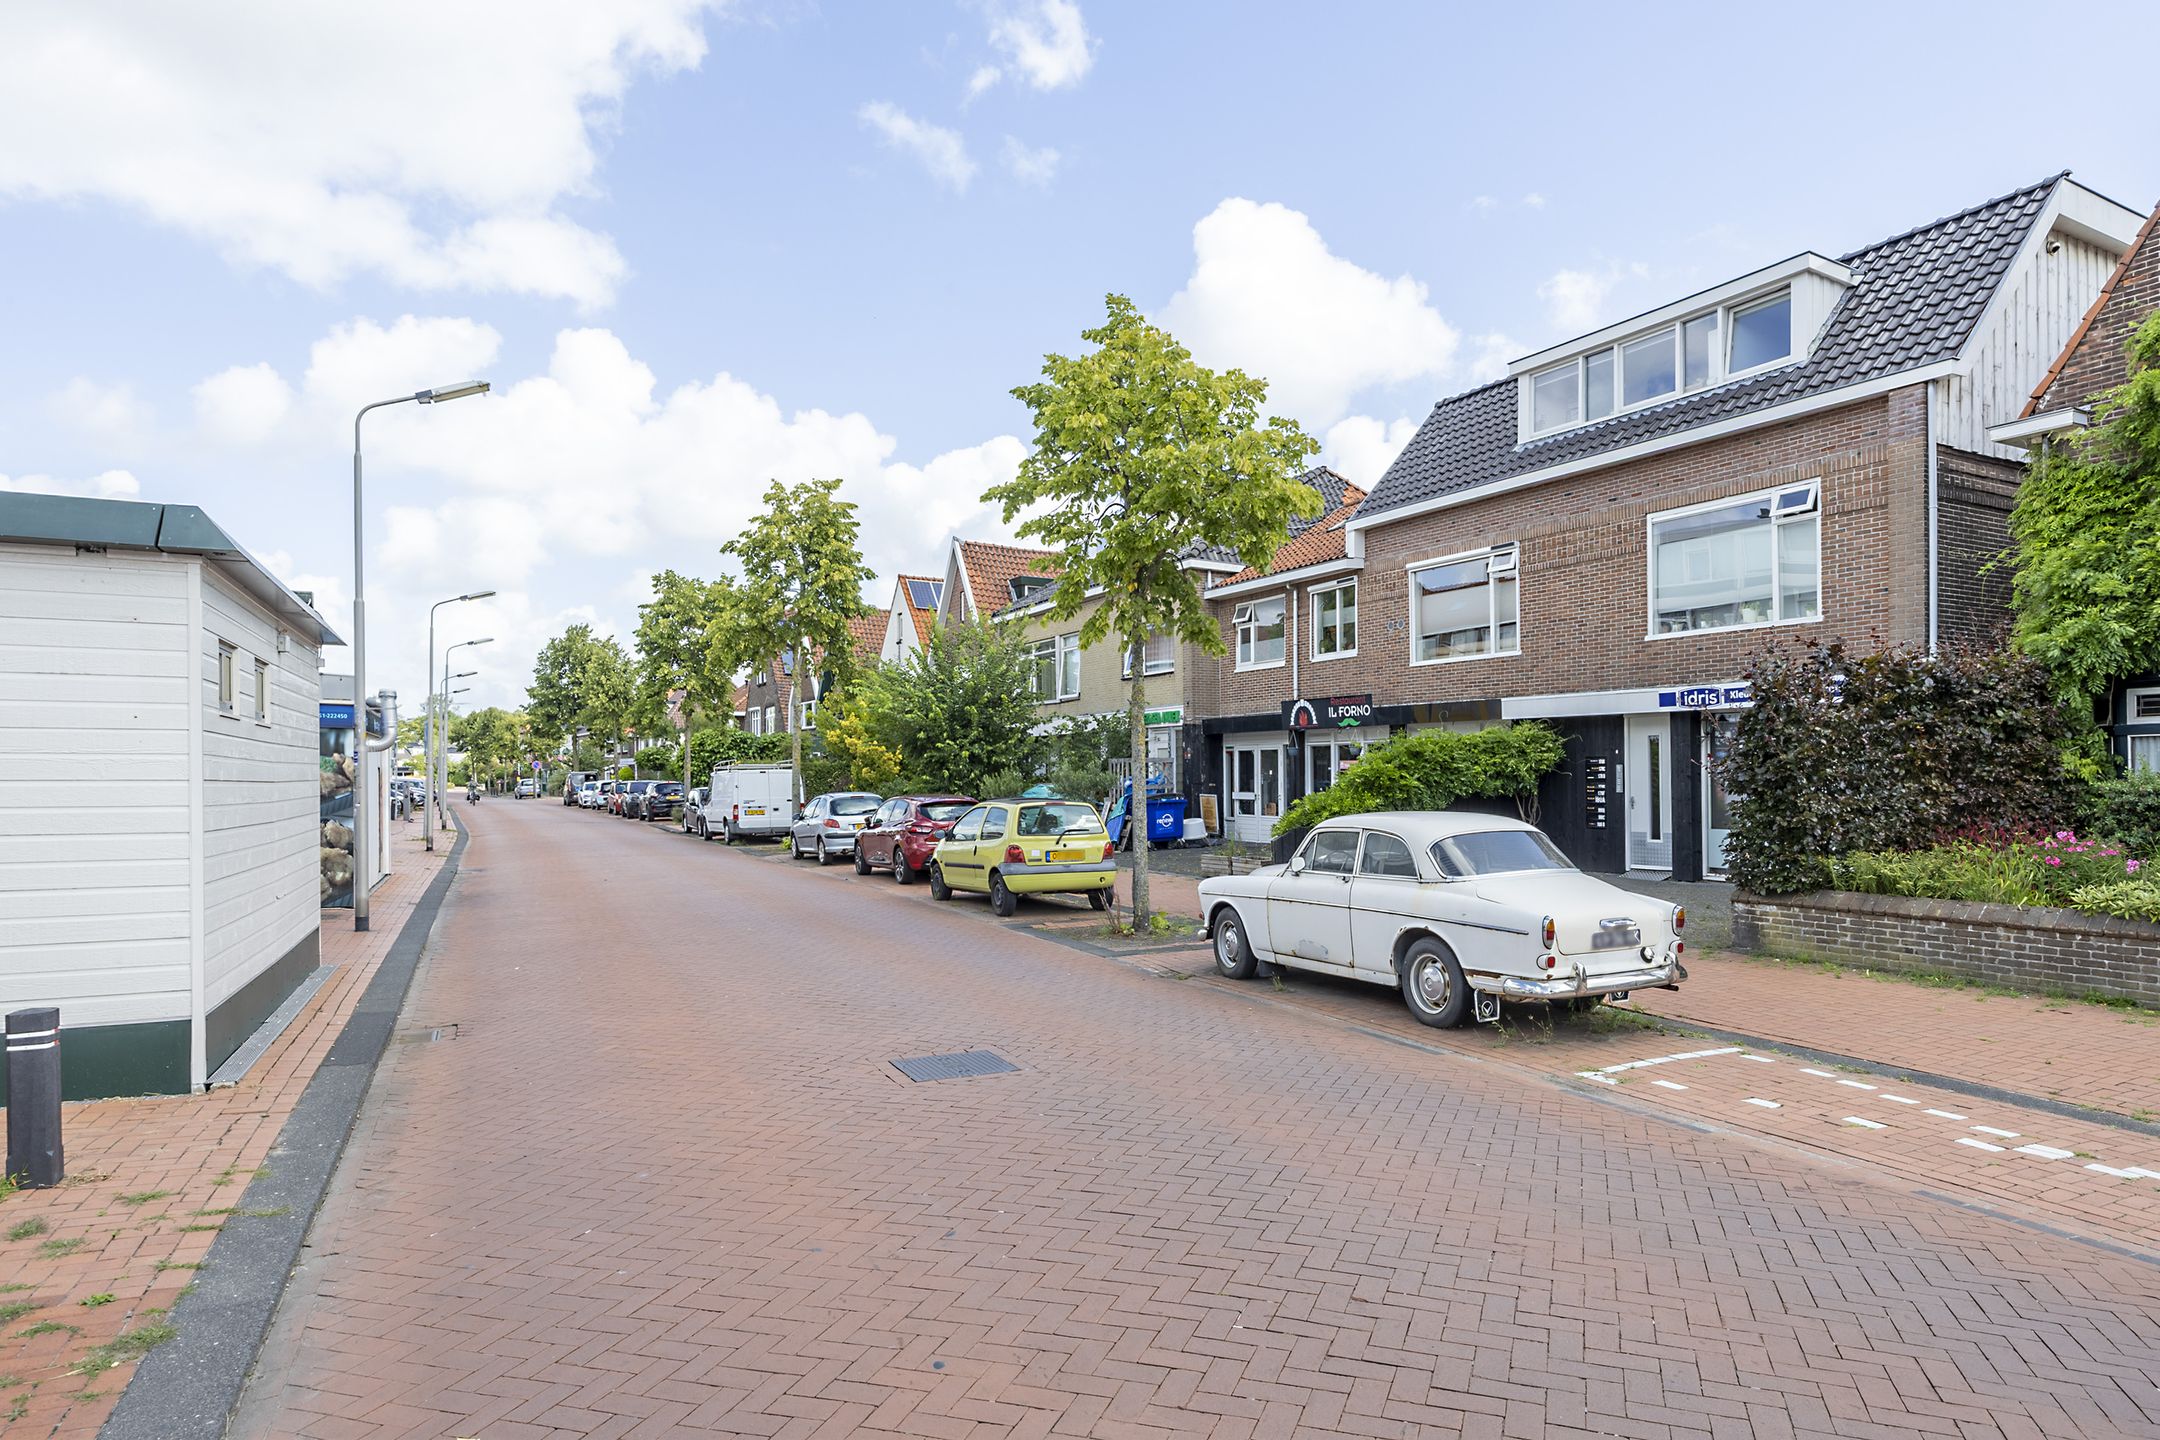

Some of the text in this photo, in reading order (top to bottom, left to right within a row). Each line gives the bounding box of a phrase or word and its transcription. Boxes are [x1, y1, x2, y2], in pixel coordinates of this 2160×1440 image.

[1330, 697, 1366, 705] Restaurant
[1684, 691, 1718, 706] idris
[1328, 704, 1371, 718] IL FORNO
